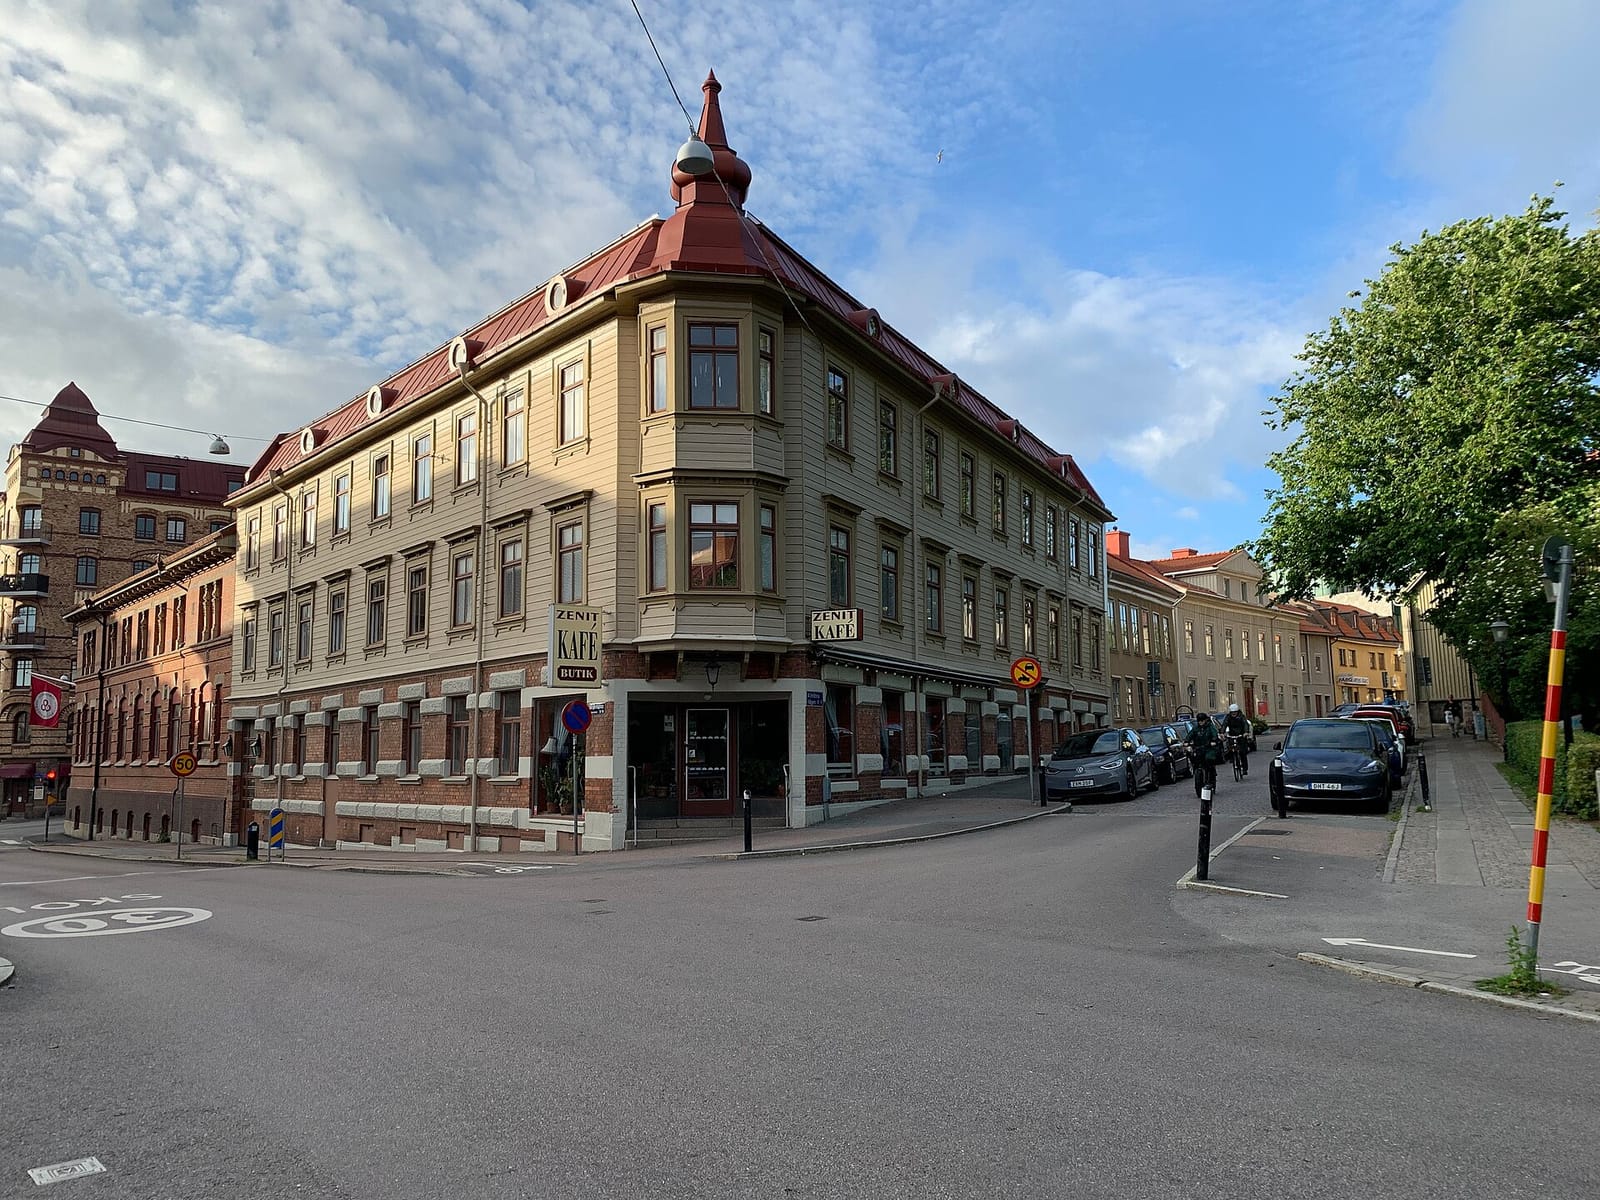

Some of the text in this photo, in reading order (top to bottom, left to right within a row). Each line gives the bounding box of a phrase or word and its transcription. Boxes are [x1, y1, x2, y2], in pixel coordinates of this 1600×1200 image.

[556, 609, 600, 622] ZENIT
[813, 610, 856, 622] ZENIT
[814, 618, 855, 640] KAFÉ
[557, 622, 598, 661] KAFÉ
[560, 668, 594, 679] BUTIK
[176, 758, 194, 771] 50
[43, 911, 187, 933] 30
